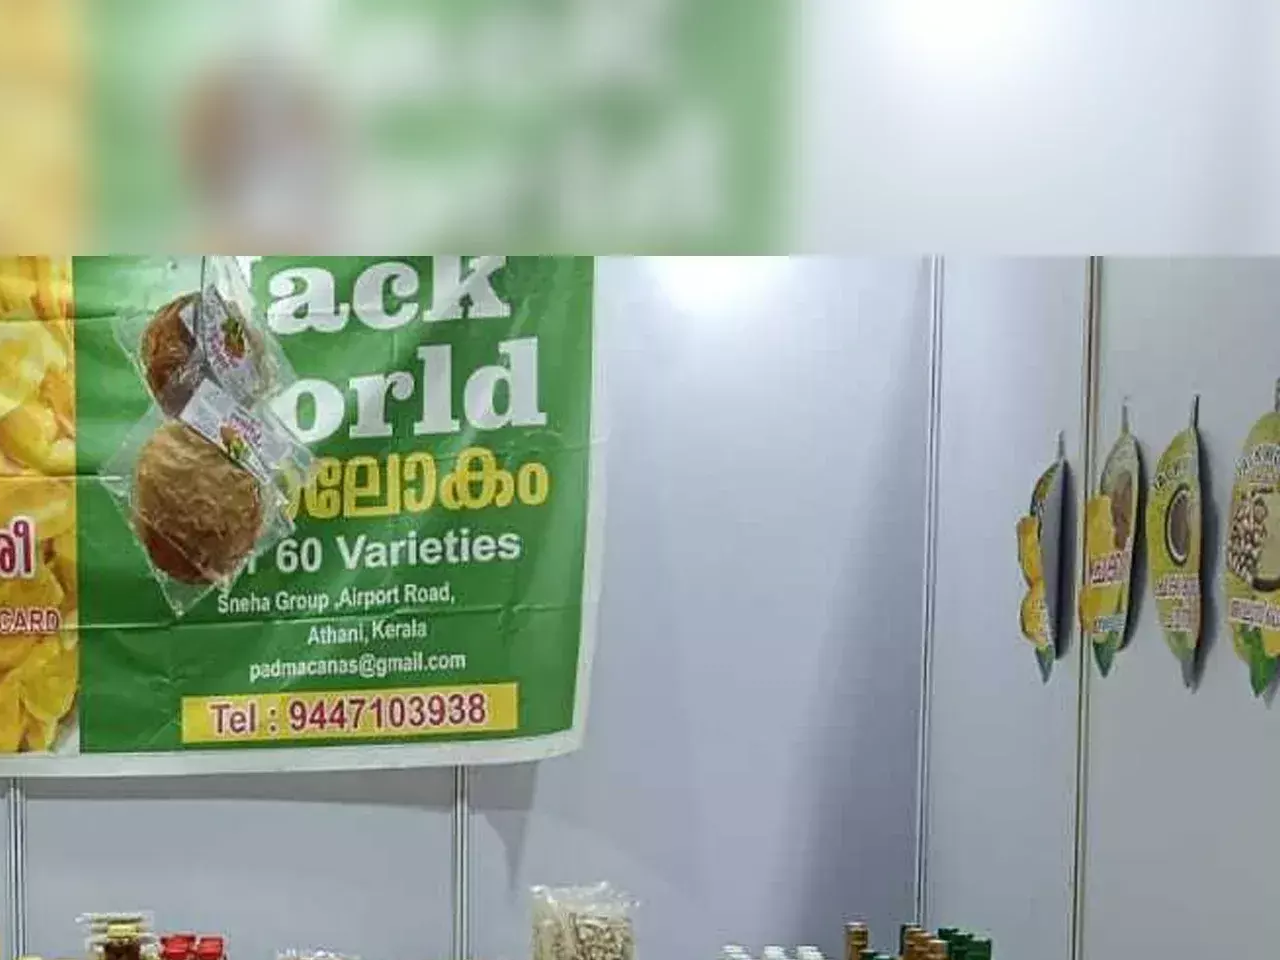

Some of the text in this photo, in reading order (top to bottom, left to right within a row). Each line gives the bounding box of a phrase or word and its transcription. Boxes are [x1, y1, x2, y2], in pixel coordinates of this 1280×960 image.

[266, 256, 513, 335] ack
[270, 337, 548, 444] orld
[276, 538, 321, 573] 60
[337, 529, 521, 571] Varieties
[218, 594, 270, 614] Sneha
[276, 591, 329, 613] Group
[405, 582, 455, 605] Road,
[308, 618, 428, 645] Athani, Kerala
[250, 652, 466, 683] padmacanas@gmail.com
[211, 704, 256, 734] Tel
[290, 692, 486, 730] 9447103938
